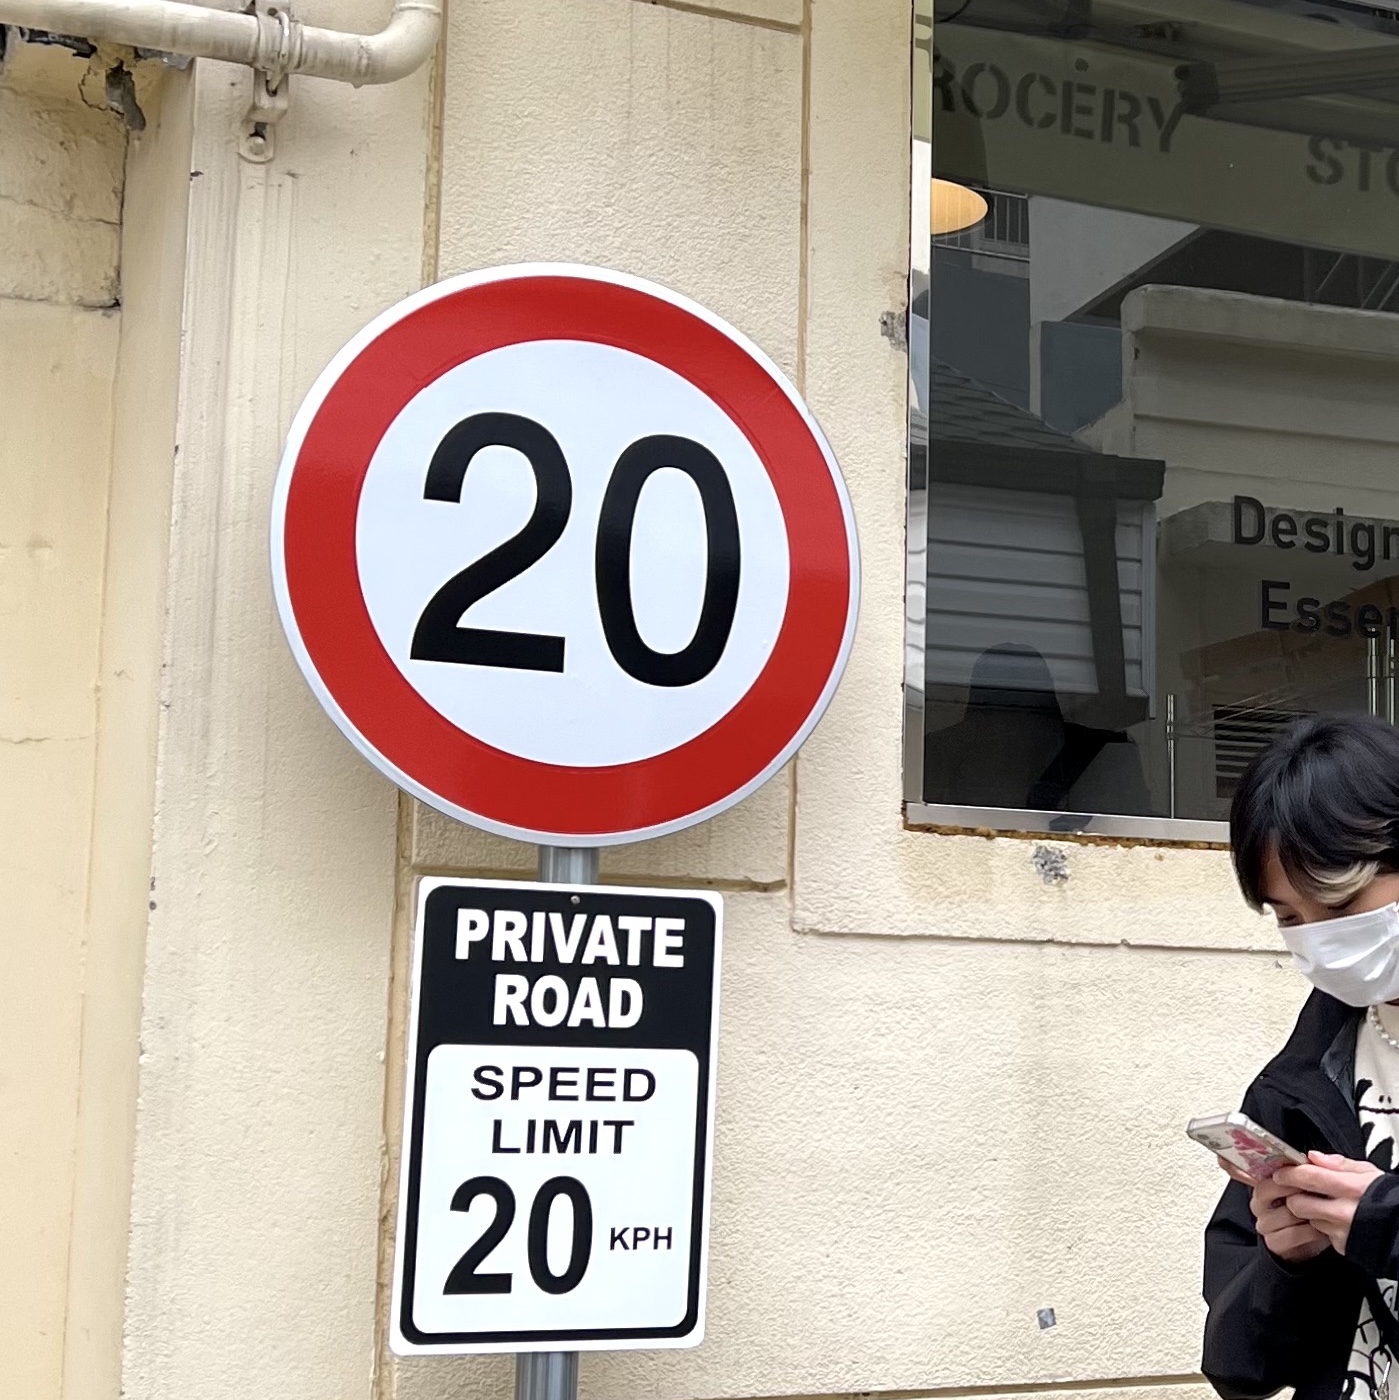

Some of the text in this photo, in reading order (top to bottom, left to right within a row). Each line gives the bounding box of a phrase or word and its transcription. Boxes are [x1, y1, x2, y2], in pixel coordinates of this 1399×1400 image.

[933, 46, 1185, 153] ROCERY
[410, 412, 741, 687] 20
[455, 908, 686, 968] PRIVATE
[492, 974, 644, 1029] ROAD
[470, 1065, 657, 1103] SPEED
[491, 1119, 635, 1155] LIMIT
[443, 1175, 673, 1295] 20 KPH
